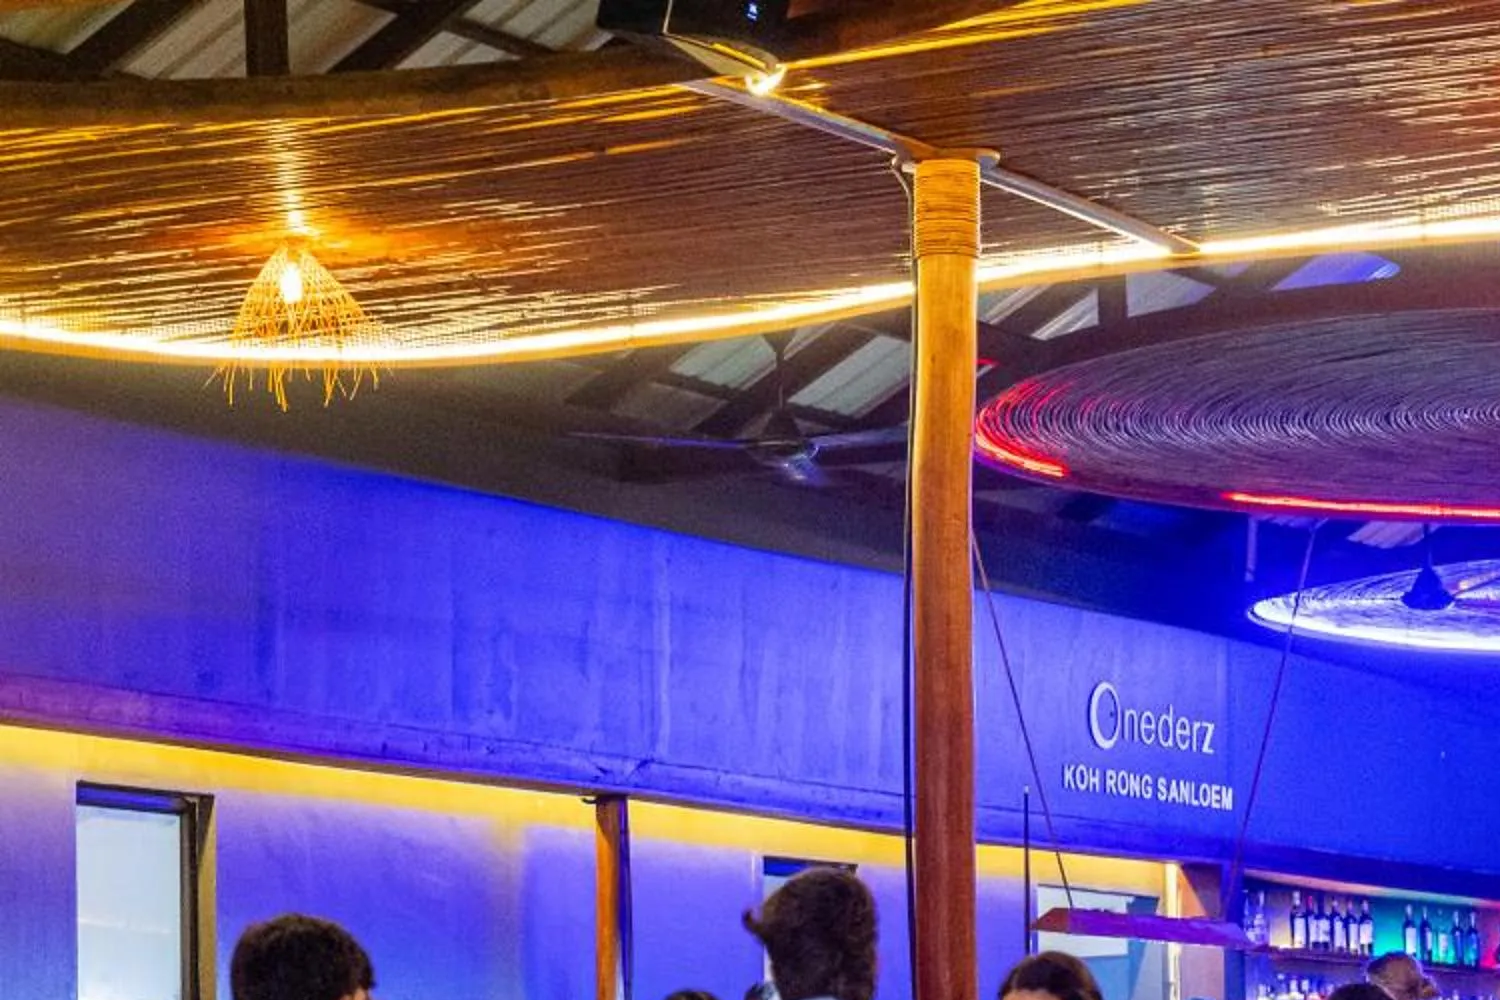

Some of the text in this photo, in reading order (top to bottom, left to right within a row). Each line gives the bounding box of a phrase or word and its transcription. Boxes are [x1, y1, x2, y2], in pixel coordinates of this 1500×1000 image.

[1089, 681, 1215, 754] Onederz
[1063, 763, 1234, 811] KOH RONG SANLOEM
